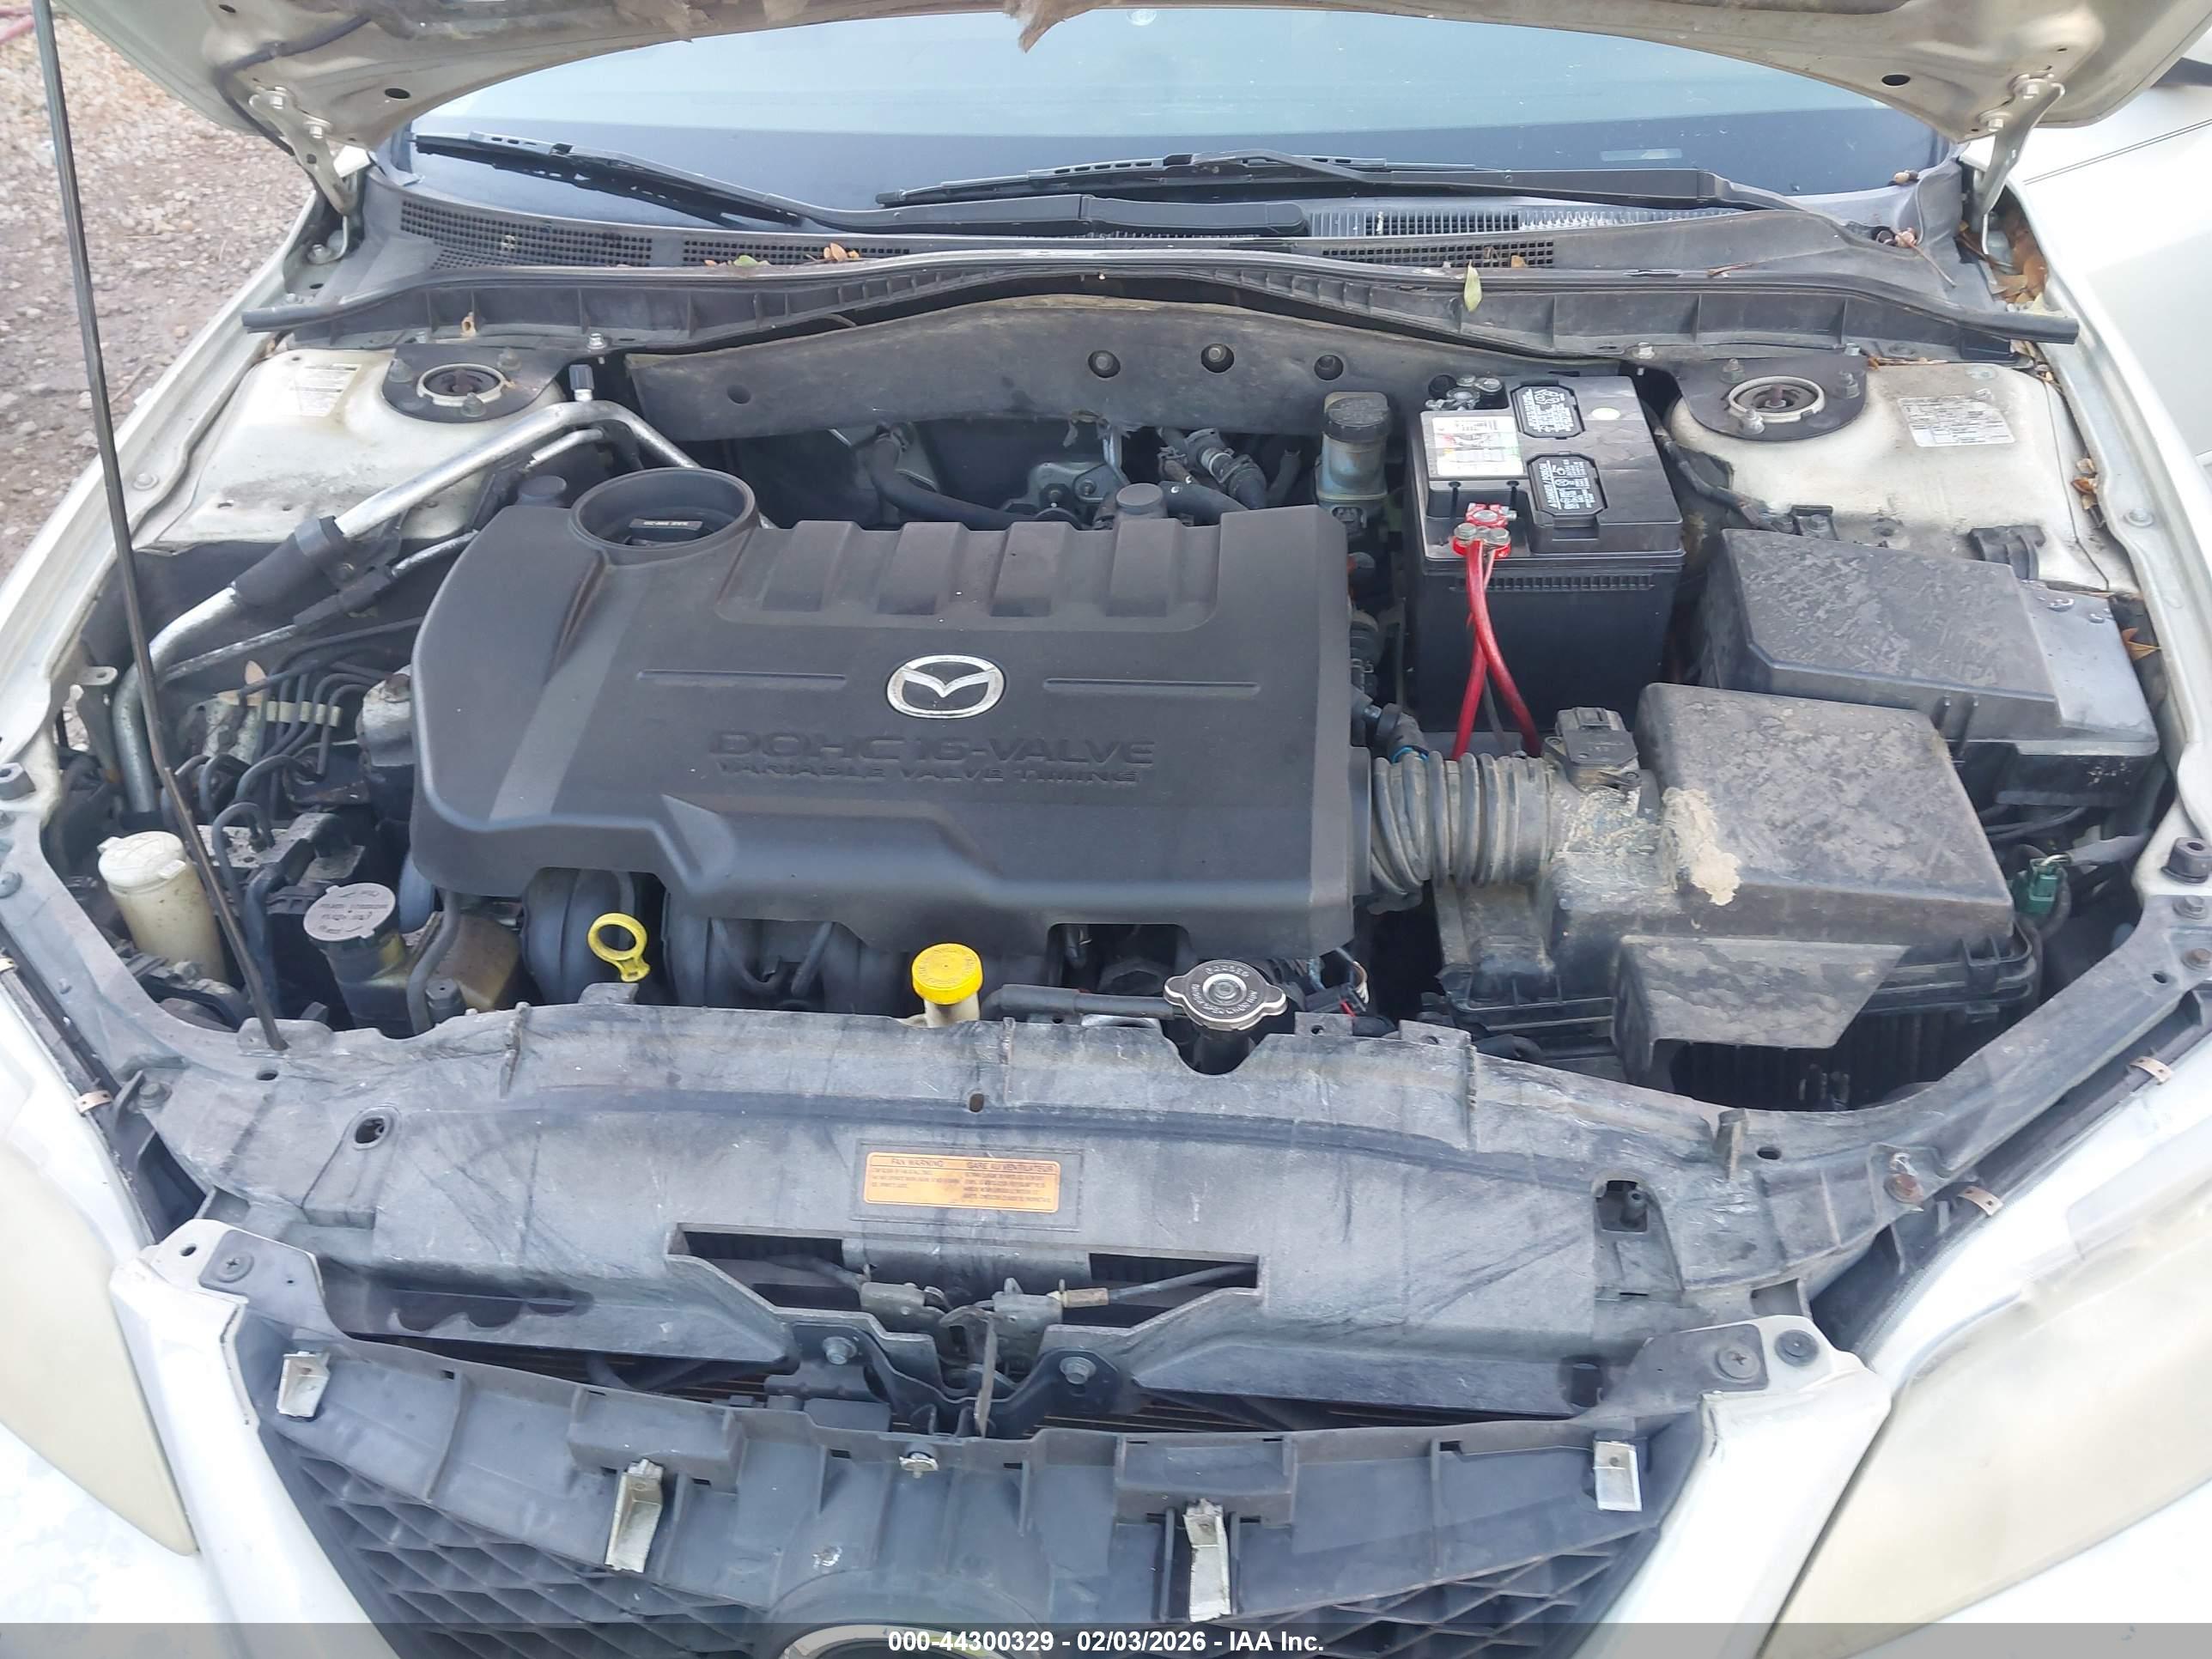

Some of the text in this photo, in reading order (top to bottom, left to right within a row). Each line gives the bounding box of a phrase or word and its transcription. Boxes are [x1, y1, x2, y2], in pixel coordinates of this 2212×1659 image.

[709, 731, 904, 761] DOHC
[900, 765, 1004, 782] VALVE
[1014, 769, 1139, 785] TIMING
